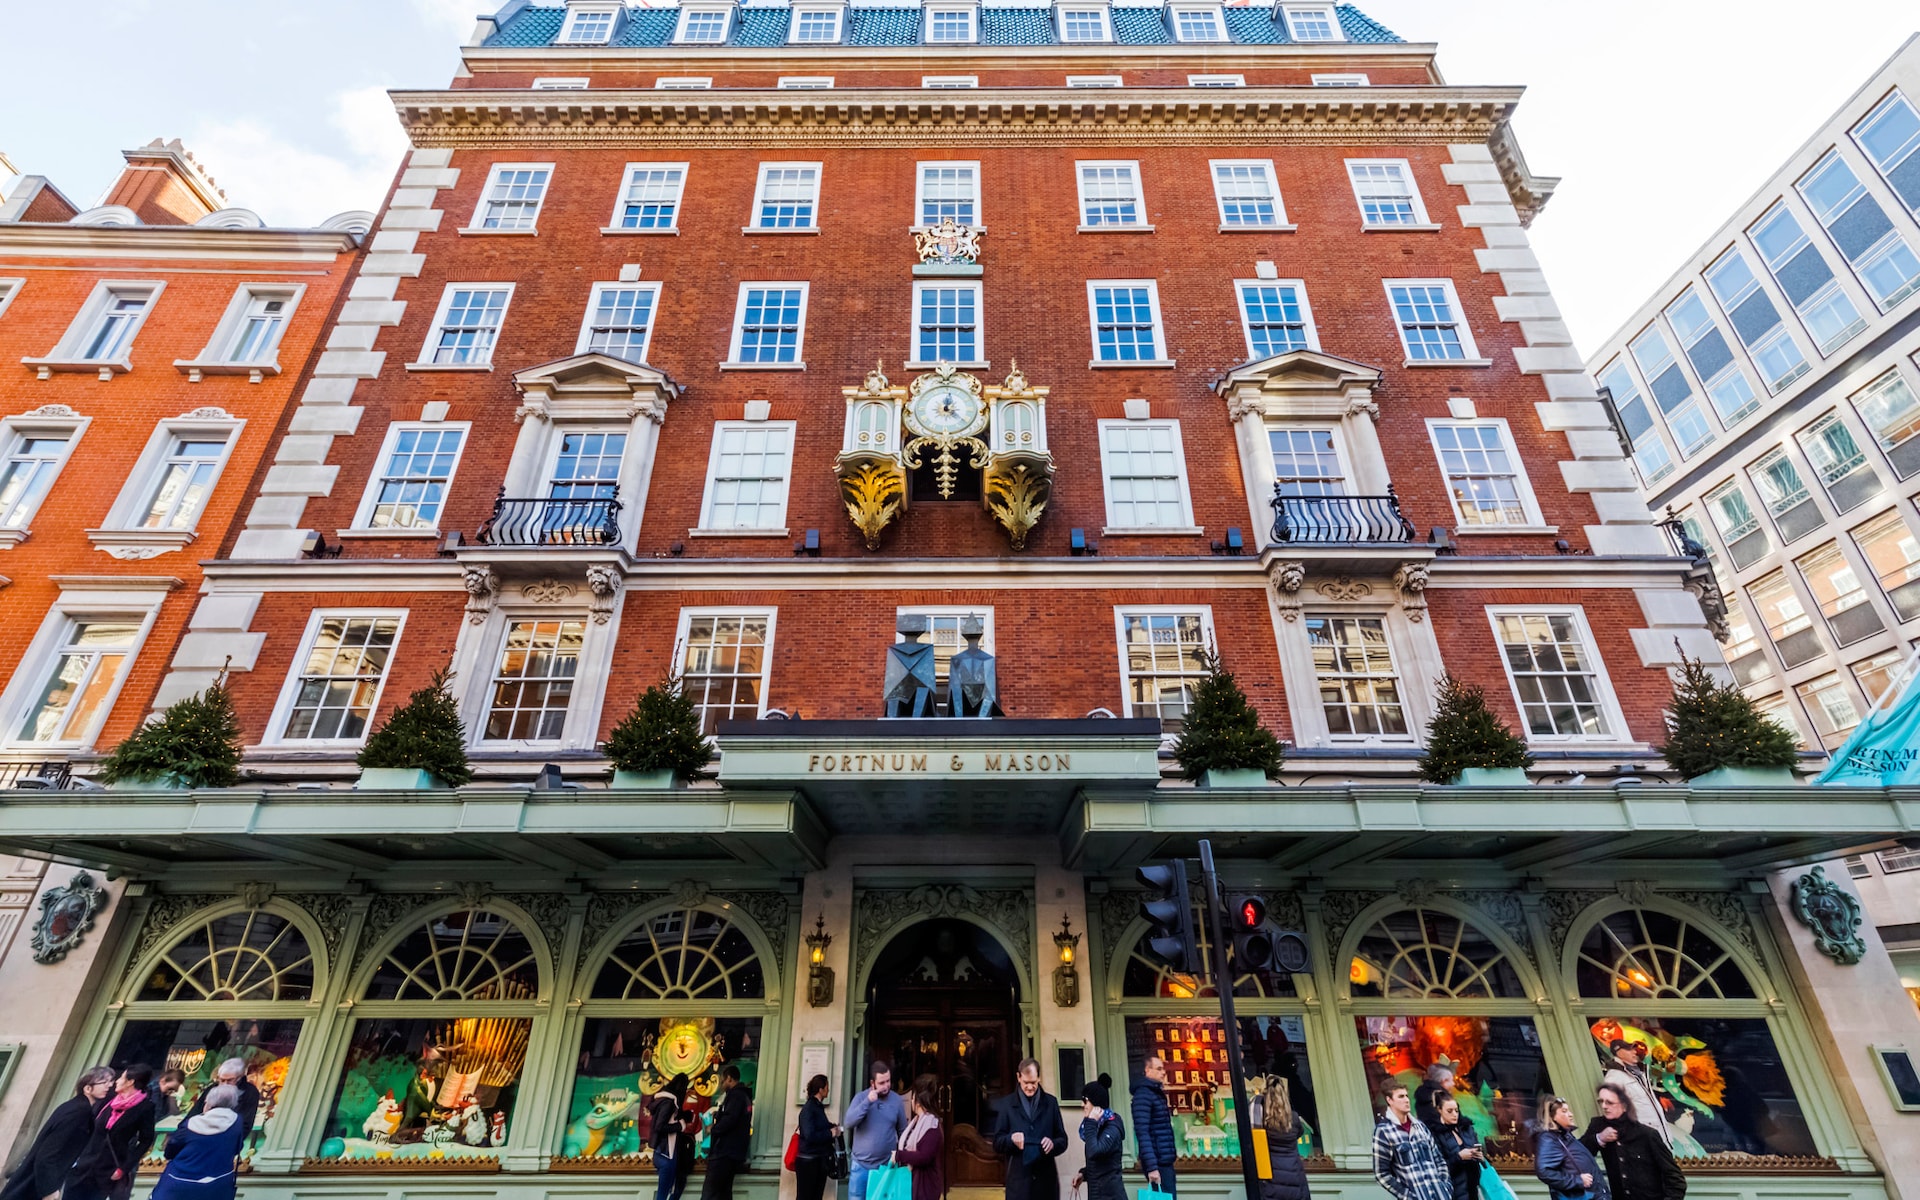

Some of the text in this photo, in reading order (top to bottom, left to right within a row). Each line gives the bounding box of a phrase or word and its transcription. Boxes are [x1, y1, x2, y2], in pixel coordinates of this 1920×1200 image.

[808, 754, 1071, 772] FORTNUM & MASON
